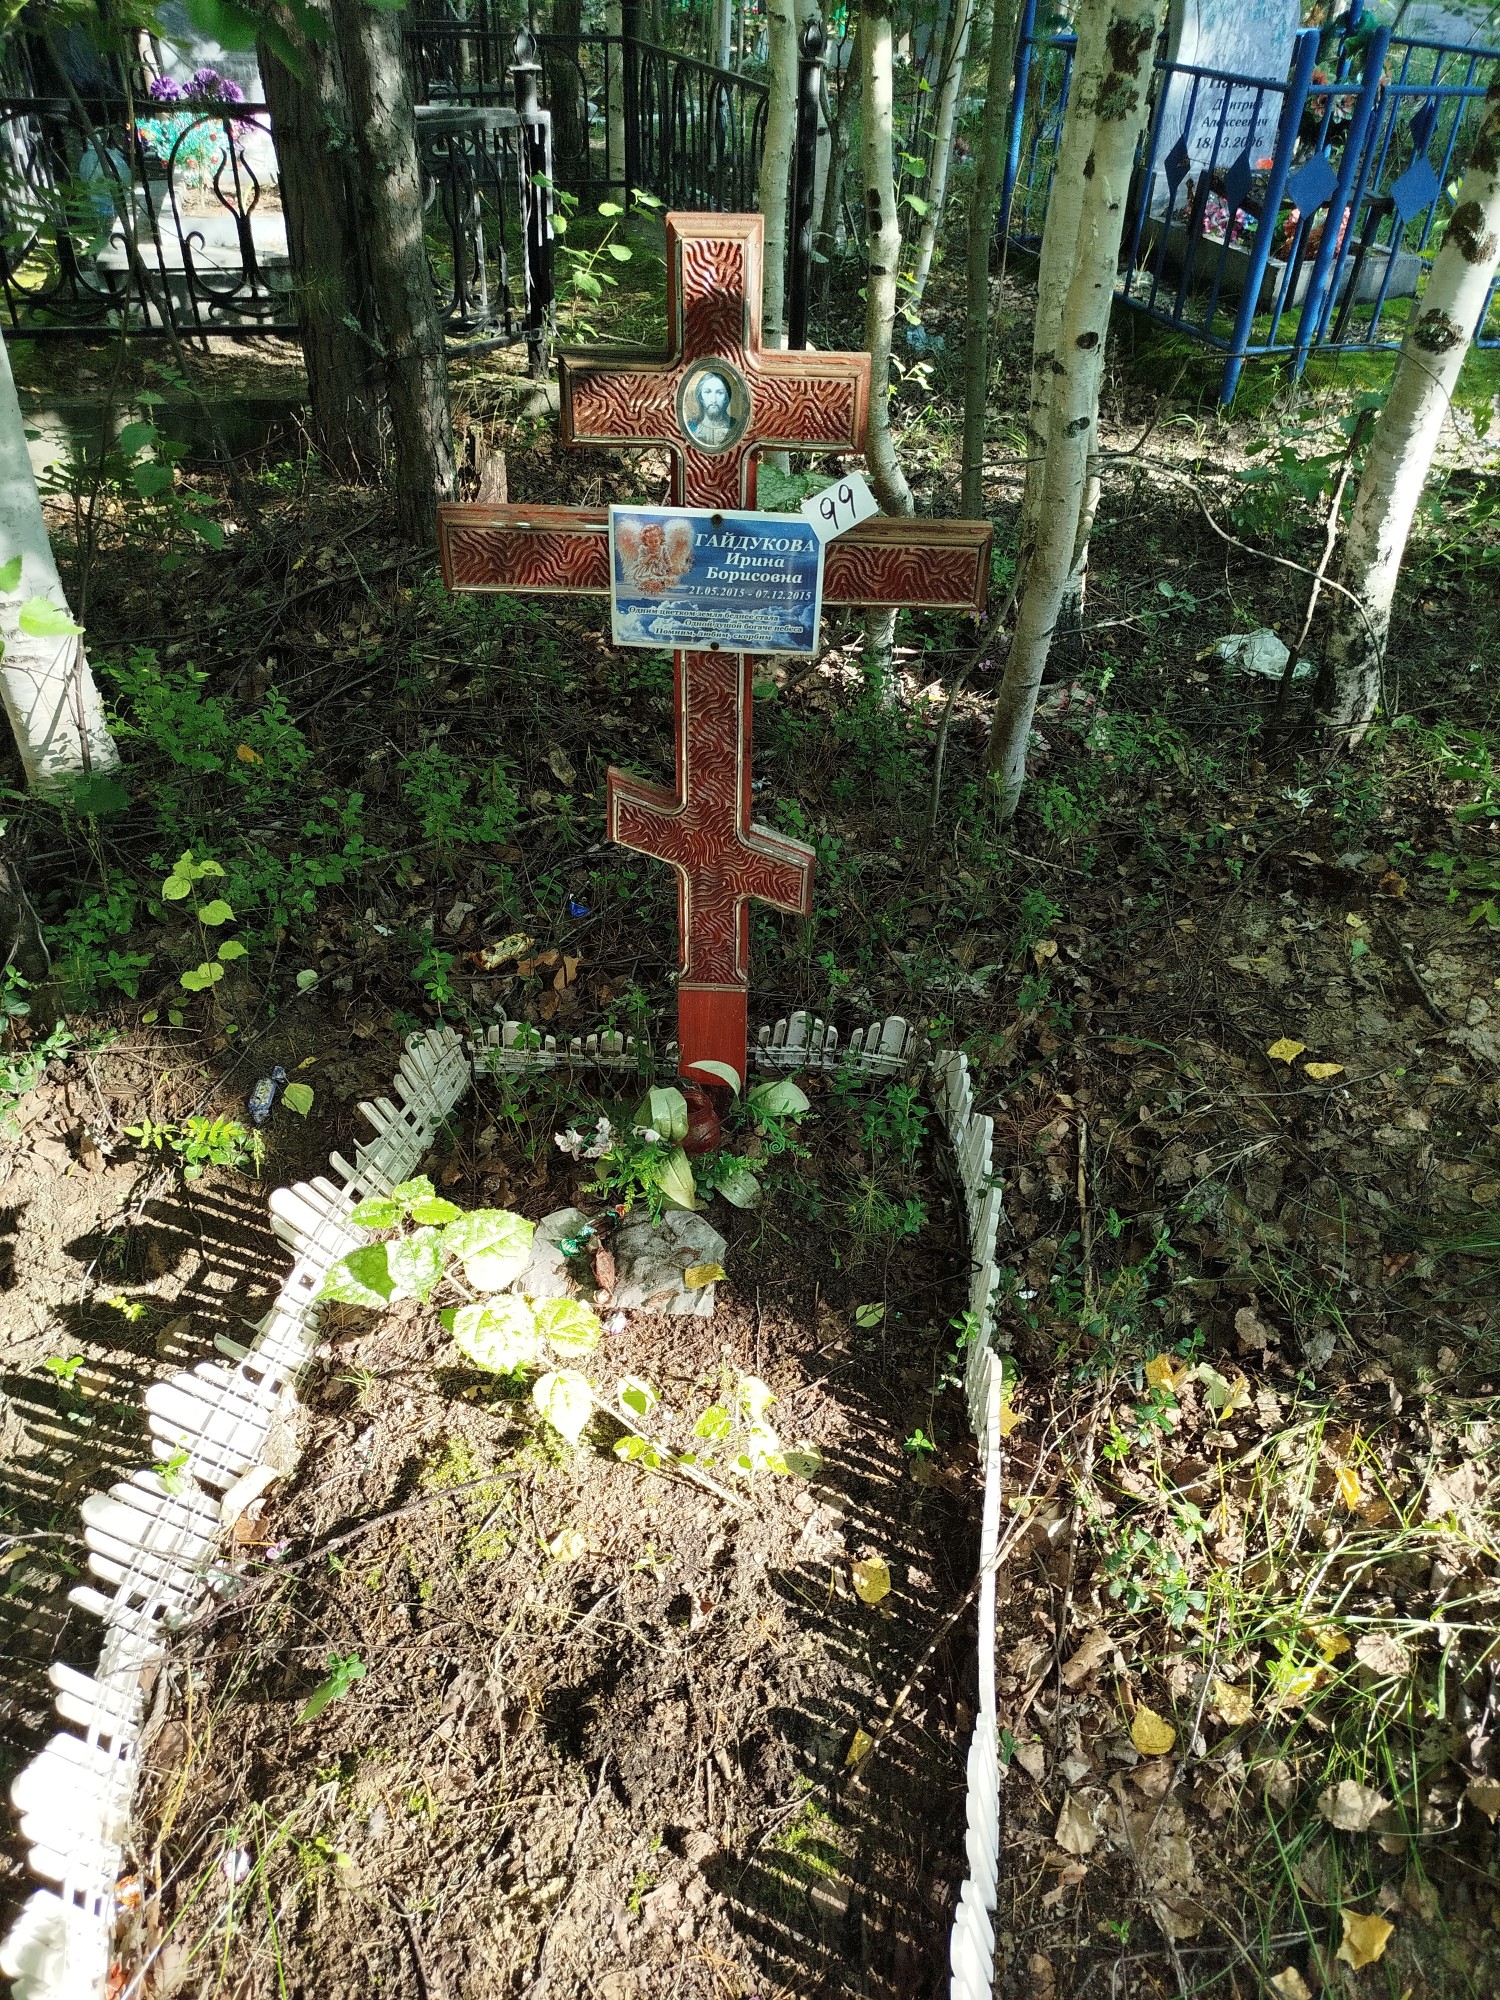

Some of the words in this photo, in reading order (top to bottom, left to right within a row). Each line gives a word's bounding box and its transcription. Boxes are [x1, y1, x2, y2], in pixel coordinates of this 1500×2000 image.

[1212, 98, 1263, 112] Дитри
[1196, 135, 1265, 149] 18.3.206
[820, 484, 856, 530] 99
[696, 532, 815, 552] ГАЙДУКОВА
[724, 552, 785, 569] Ирина
[705, 567, 803, 584] Борисовна
[689, 586, 745, 597] 21.05.2015
[755, 589, 811, 601] 07.12.2015
[629, 606, 658, 615] Одним
[660, 609, 695, 617] цветком
[697, 611, 723, 619] земля
[724, 612, 754, 620] беднее
[685, 619, 712, 628] Одной
[714, 622, 743, 630] душой
[744, 623, 773, 631] богаче
[774, 625, 803, 633] небеса
[655, 628, 695, 637] Помним,
[697, 630, 731, 639] любим,
[733, 633, 772, 641] скорбим
